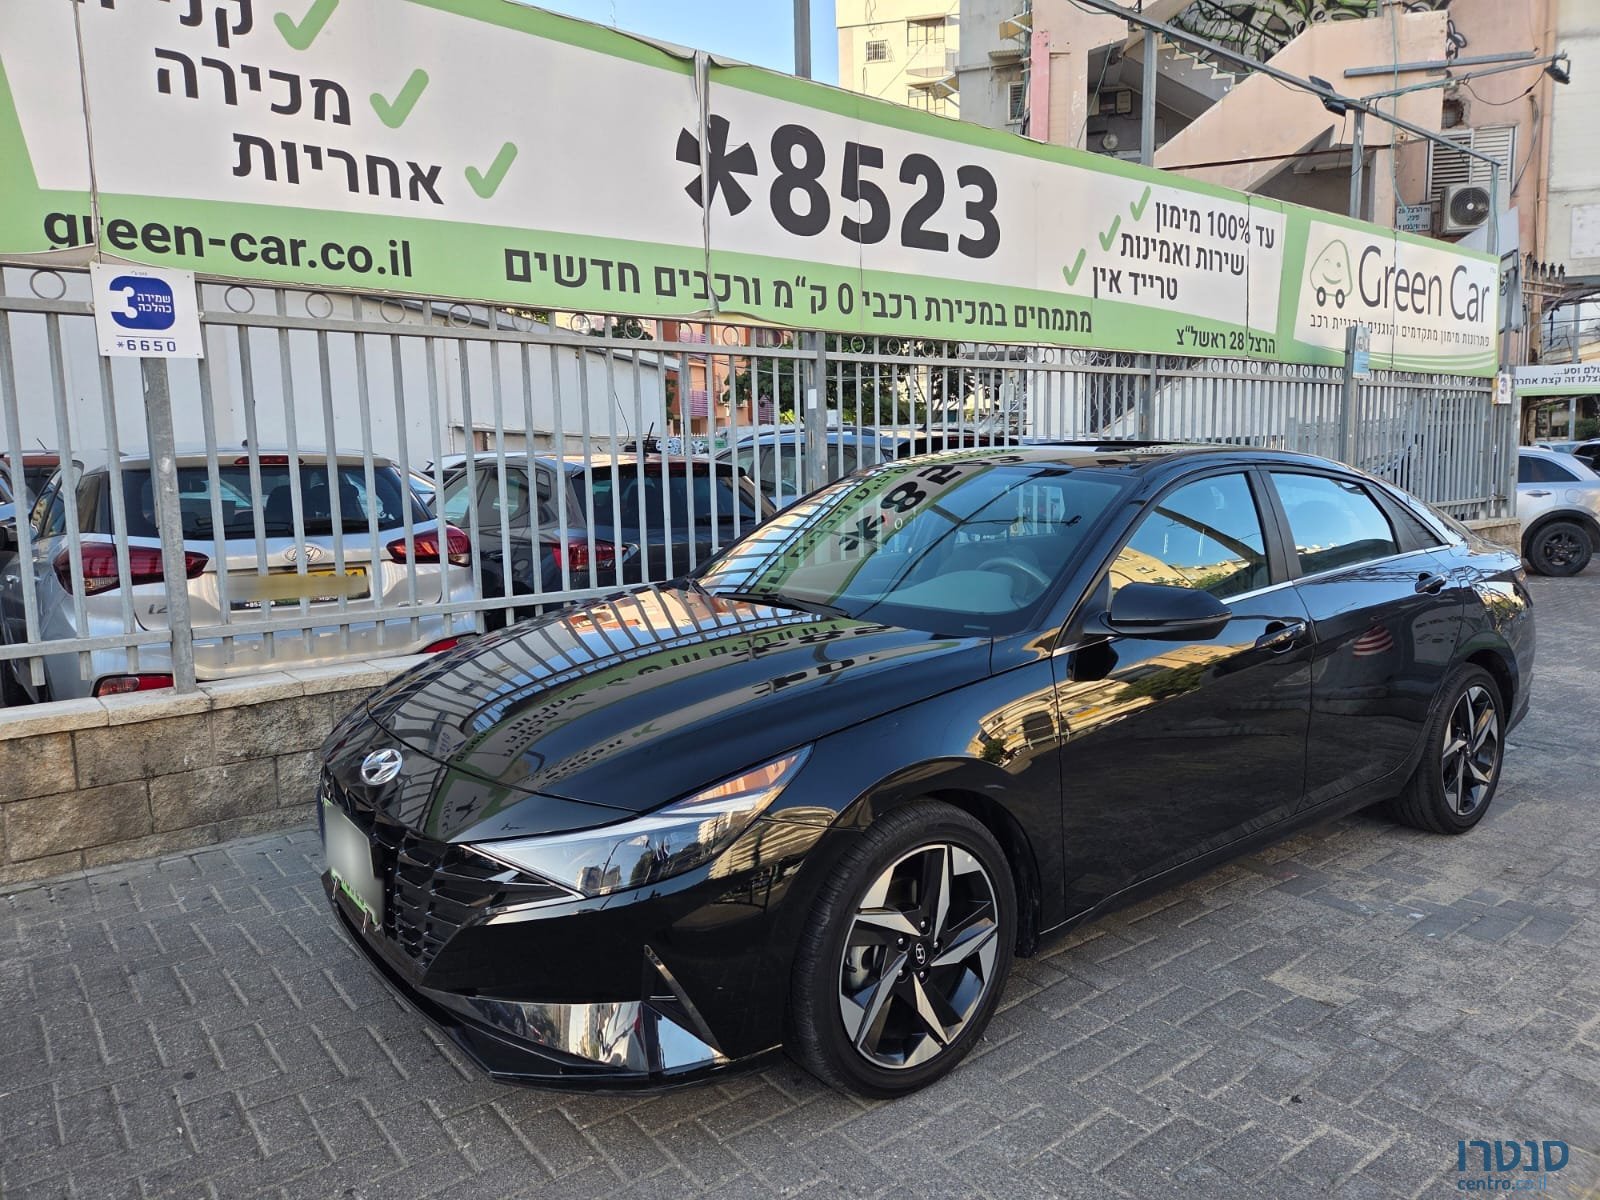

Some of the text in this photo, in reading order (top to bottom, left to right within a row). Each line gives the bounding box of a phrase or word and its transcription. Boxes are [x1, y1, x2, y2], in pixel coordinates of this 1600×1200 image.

[155, 48, 351, 126] מכירה
[233, 132, 444, 205] אחריות
[1156, 202, 1274, 249] עד 100% מימון
[43, 211, 412, 277] green-car.co.il
[1120, 233, 1244, 276] שירות ואמינות
[504, 248, 641, 294] חדשים
[1093, 266, 1178, 300] טרייד אין
[1359, 245, 1490, 323] Green Car
[137, 293, 171, 303] שמירה
[654, 266, 761, 305] ורכבים
[862, 291, 917, 319] רכבי
[925, 297, 1007, 326] במכירת
[1014, 305, 1092, 333] מתמחים
[1310, 313, 1328, 329] רכב
[1402, 325, 1438, 341] מתקדמים
[1229, 331, 1244, 350] 28
[1248, 332, 1275, 354] הרצל
[1440, 329, 1460, 344] מימון
[1462, 332, 1490, 347] פתרונות
[1541, 377, 1561, 386] קצת
[1578, 375, 1600, 383] צלנו
